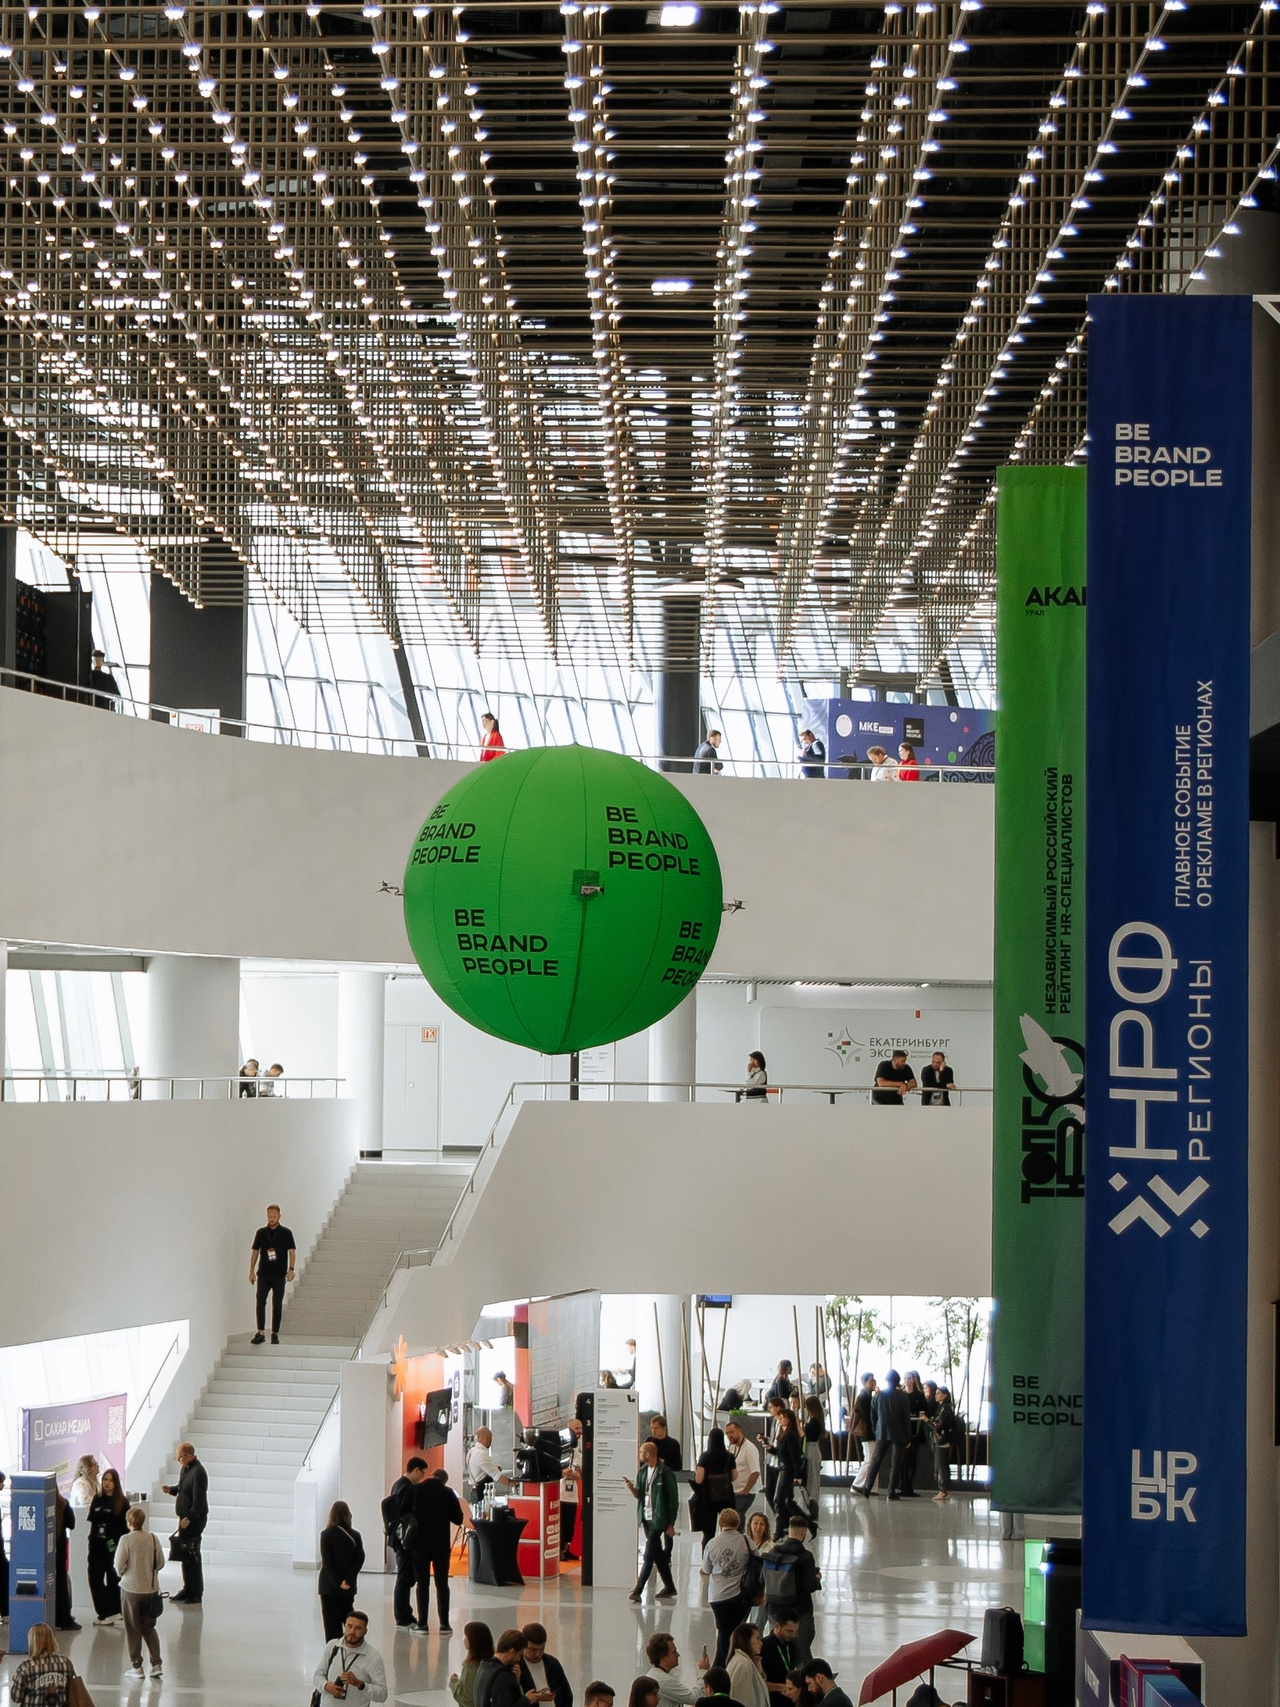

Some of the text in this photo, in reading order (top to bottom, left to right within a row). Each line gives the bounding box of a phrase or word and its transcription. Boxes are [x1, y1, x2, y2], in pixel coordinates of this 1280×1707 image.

[1115, 423, 1150, 441] BE
[1115, 446, 1211, 464] BRAND
[1115, 469, 1223, 487] PEOPLE
[1196, 680, 1213, 907] О РЕКЛАМЕ В РЕГИОНАХ
[430, 804, 450, 820] BE
[606, 806, 639, 823] BE
[1175, 725, 1191, 907] ГЛАВНОЕ СОБЫТИЕ
[419, 823, 476, 842] BRAND
[608, 827, 689, 850] BRAND
[412, 845, 481, 866] PEOPLE
[609, 851, 700, 876] PEOPLE
[1043, 767, 1058, 1014] НЕЗАВИСИМЫЙ РОССИЙСКИЙ
[1057, 774, 1074, 1014] РЕЙТИНГ HR-СПЕЦИАЛИСТОВ
[454, 909, 485, 927] BE
[679, 921, 703, 940] BE
[457, 934, 548, 952] BRAND
[671, 944, 713, 966] BRAN
[462, 957, 559, 976] PEOPLE
[661, 967, 701, 987] PEOP
[870, 1037, 950, 1048] ЕКАТЕРИНБУРГ
[1108, 921, 1178, 1160] НРФ
[870, 1049, 909, 1058] ЭКСО
[1187, 960, 1212, 1161] РЕГИОНЫ
[1013, 1375, 1039, 1389] BE
[1013, 1411, 1083, 1426] PEOPL
